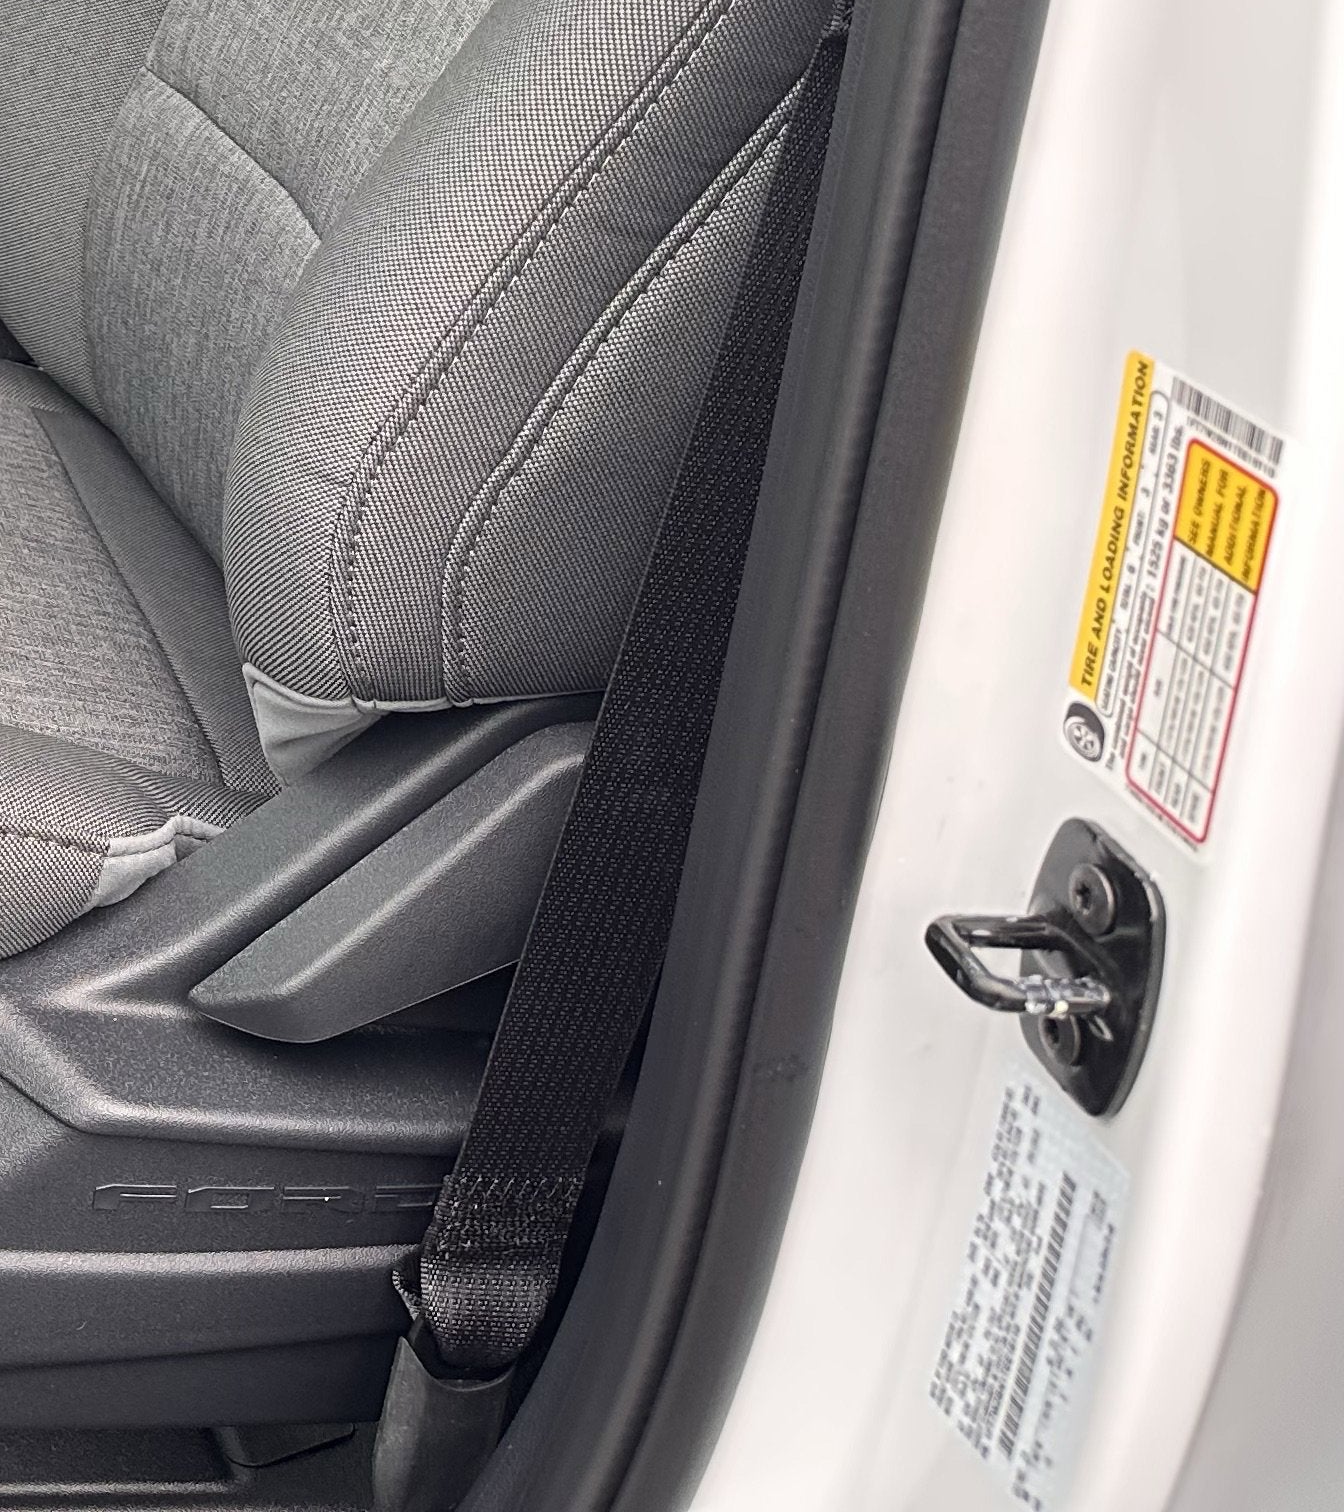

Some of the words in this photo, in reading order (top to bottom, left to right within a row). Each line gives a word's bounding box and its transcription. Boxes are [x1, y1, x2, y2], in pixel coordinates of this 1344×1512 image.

[1160, 495, 1170, 516] or
[1080, 640, 1099, 691] TIRE
[1090, 594, 1107, 641] AND
[1099, 502, 1125, 595] LOADING
[1112, 357, 1152, 503] INFORMATION
[1154, 514, 1169, 541] kg
[1146, 536, 1163, 580] 1525
